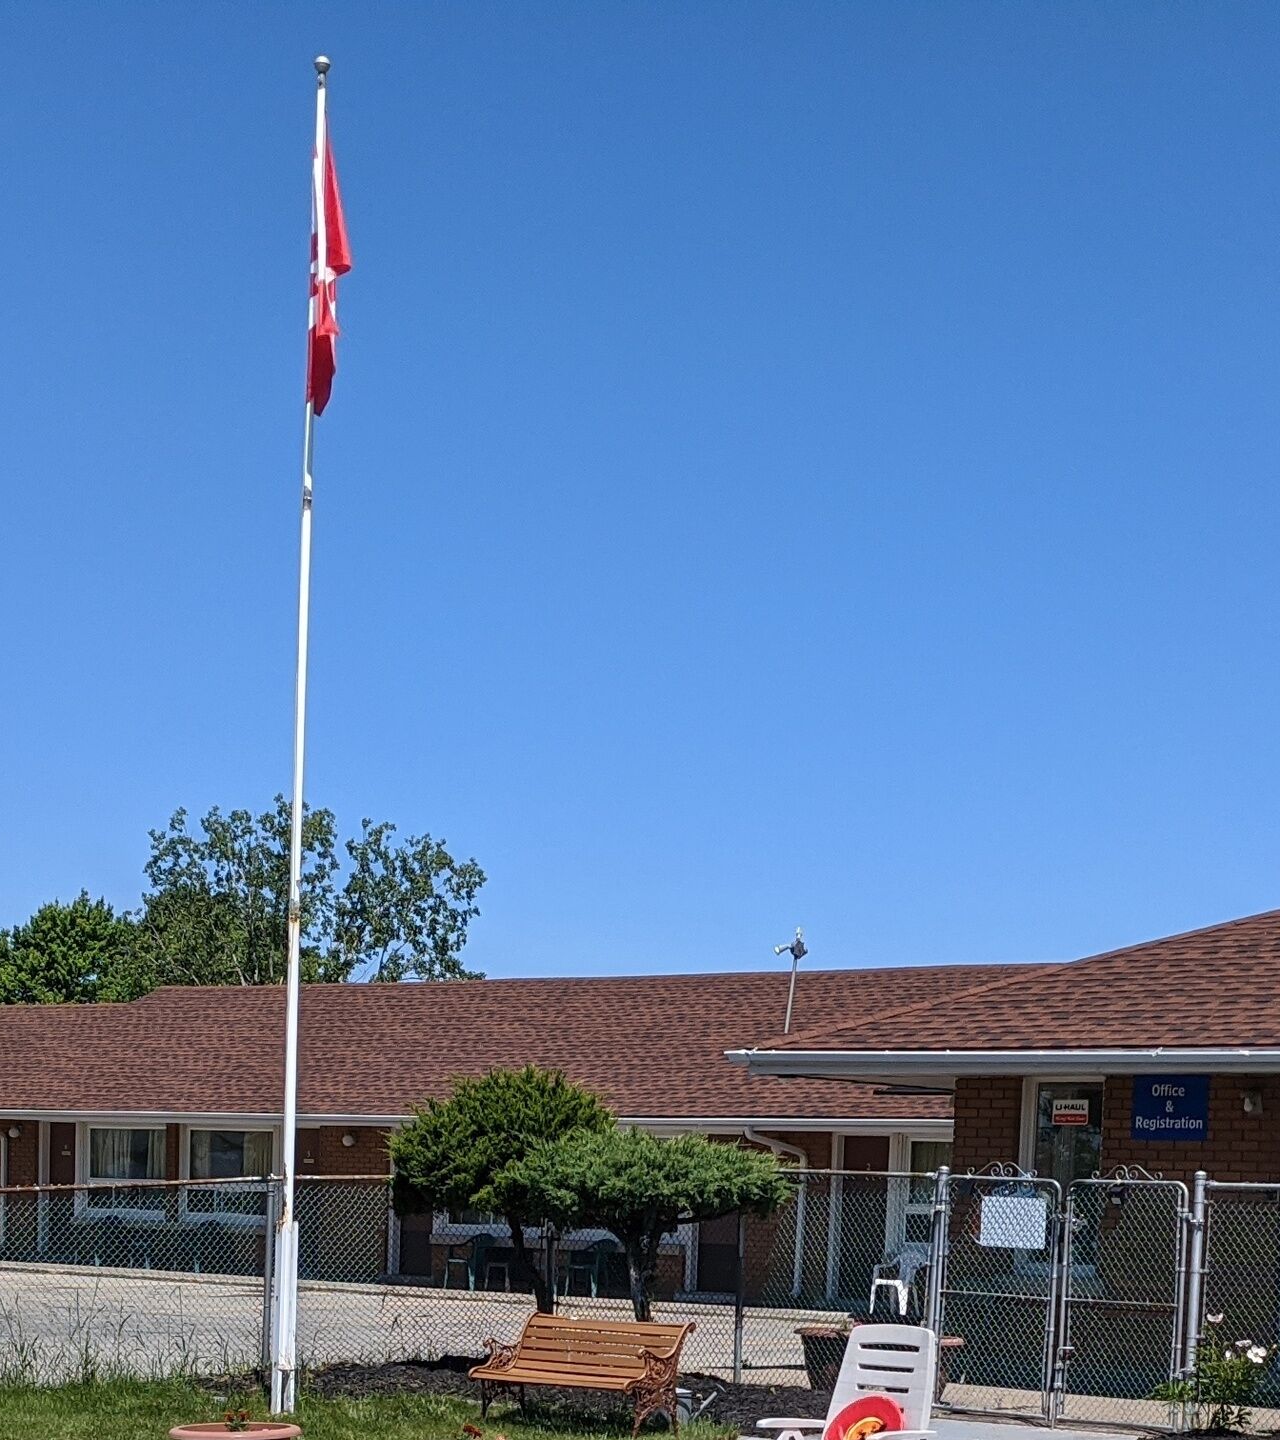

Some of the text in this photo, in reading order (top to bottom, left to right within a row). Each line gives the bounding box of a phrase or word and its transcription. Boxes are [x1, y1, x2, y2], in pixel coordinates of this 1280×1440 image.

[1151, 1084, 1186, 1097] Office
[1165, 1100, 1174, 1113] &
[1135, 1116, 1203, 1131] Registration
